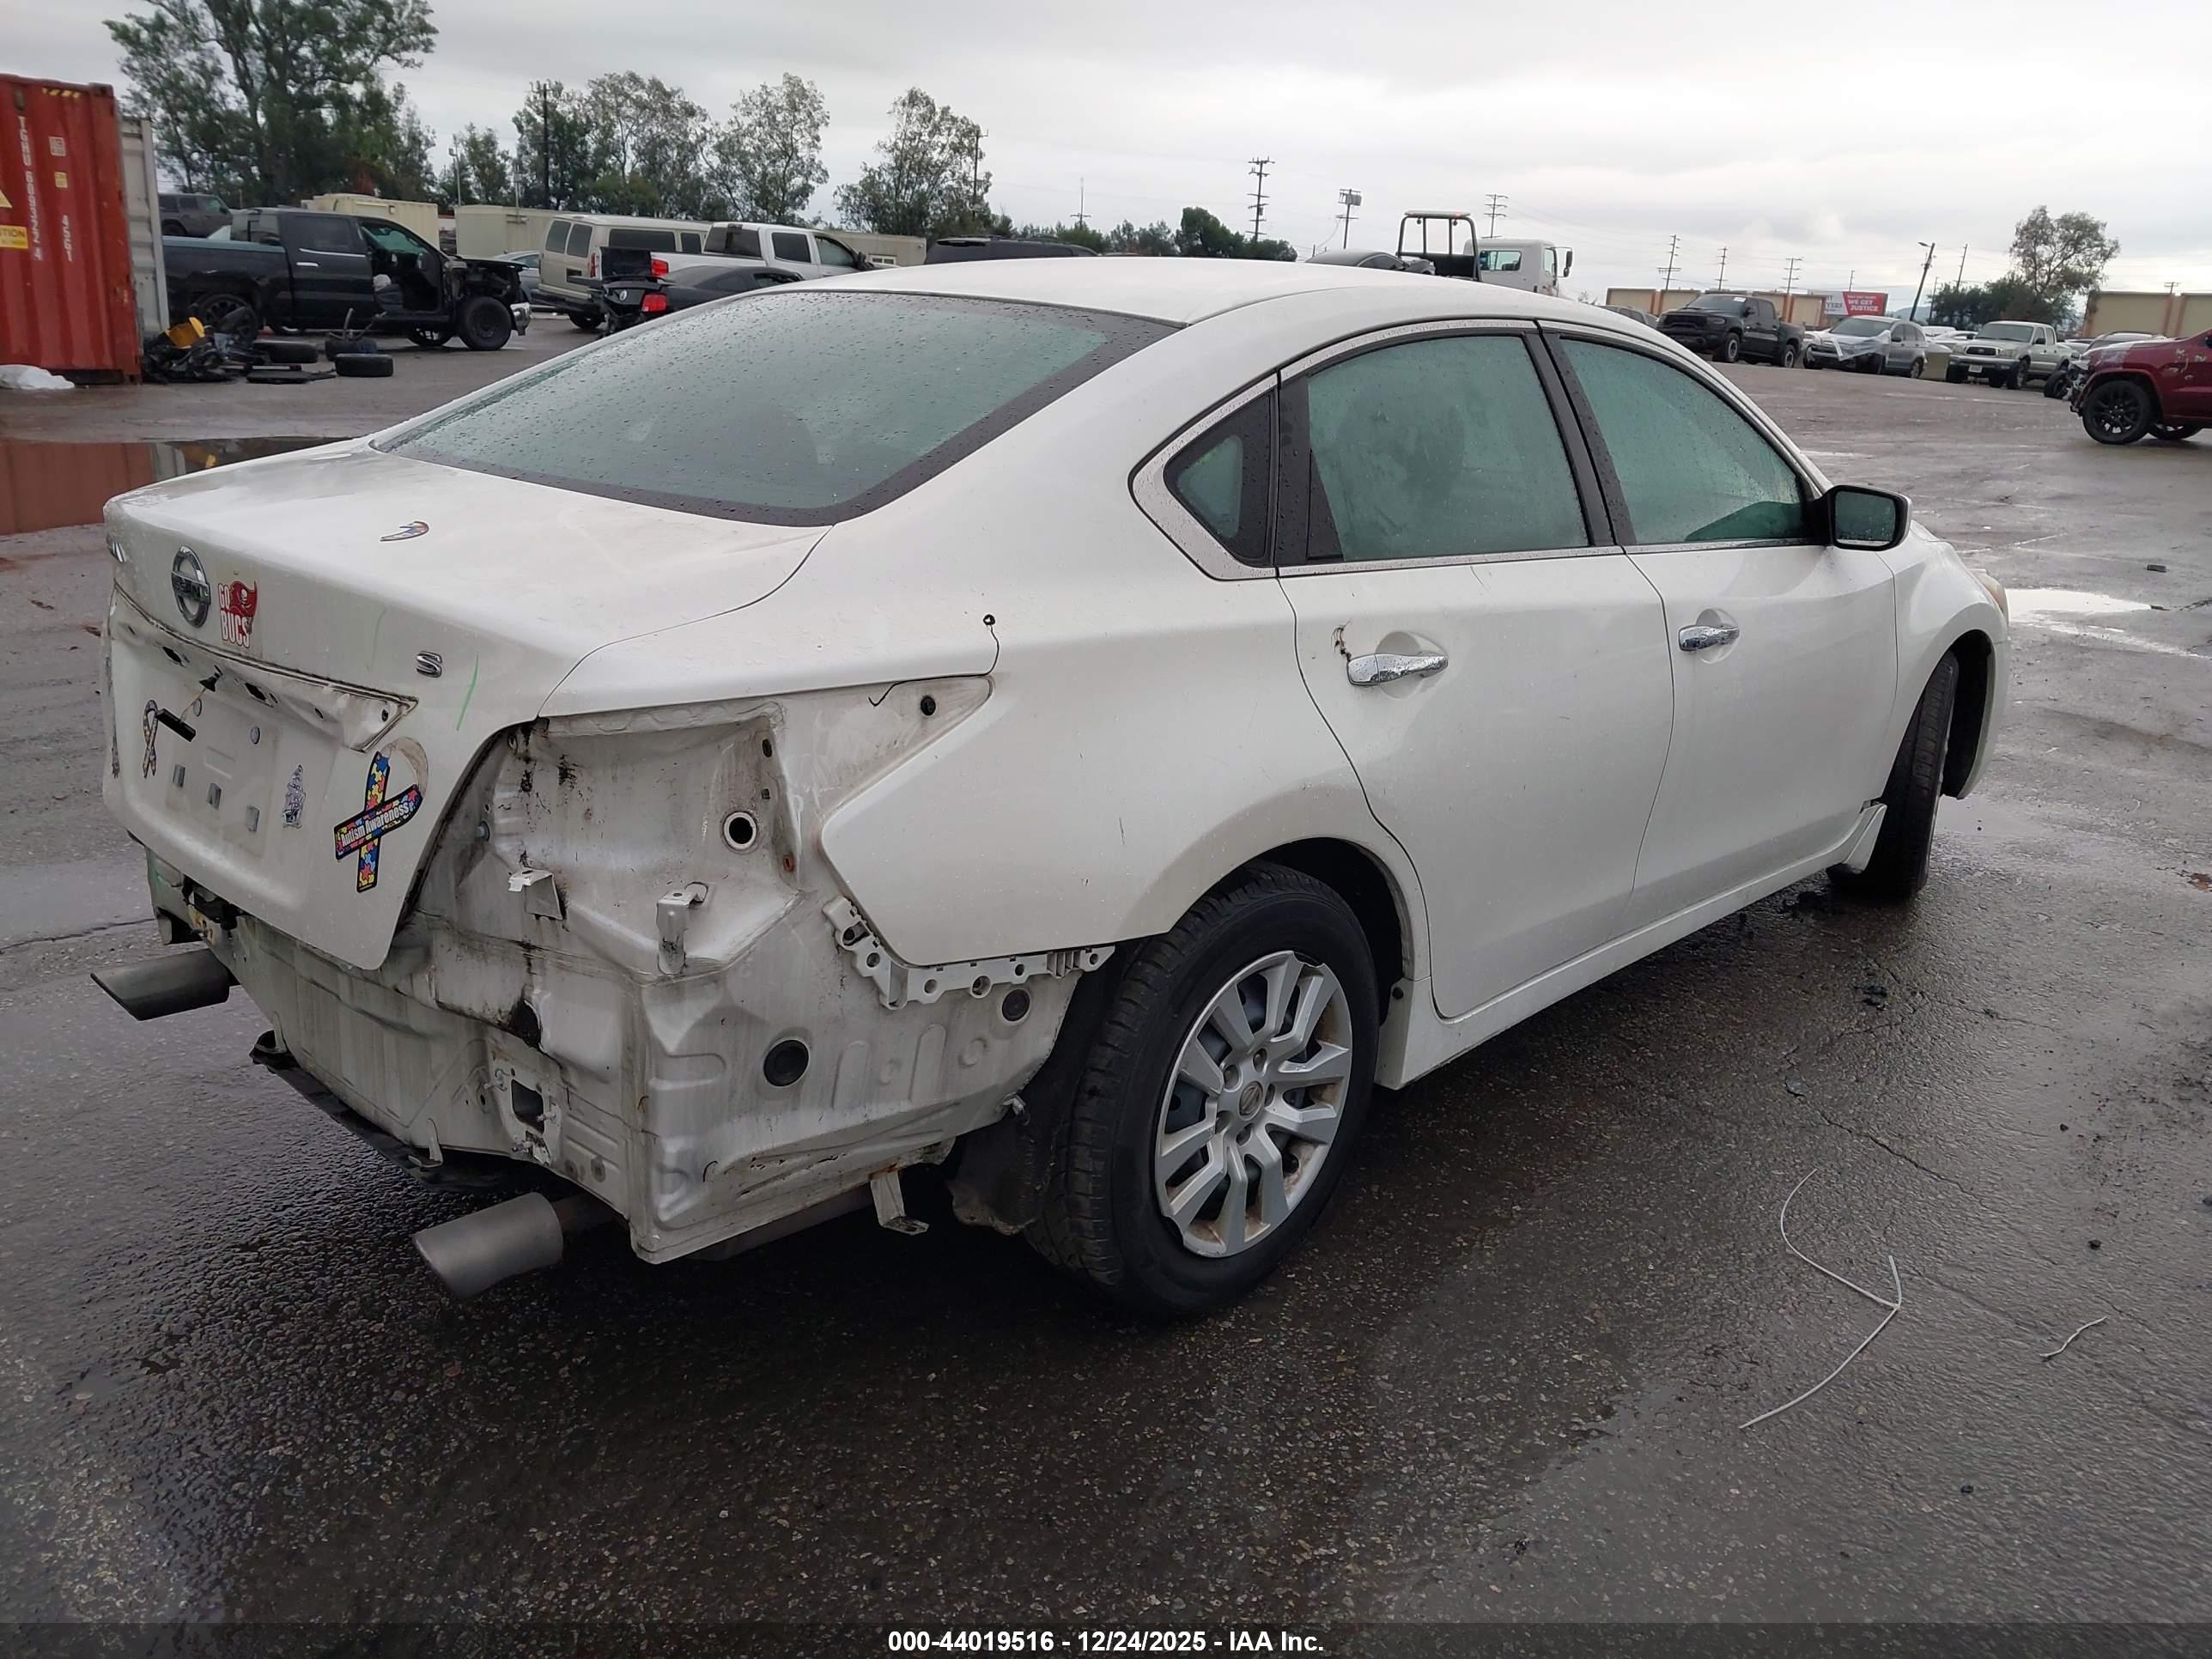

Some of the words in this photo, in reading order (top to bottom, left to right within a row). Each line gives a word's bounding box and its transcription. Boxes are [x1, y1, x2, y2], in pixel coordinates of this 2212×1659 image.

[218, 583, 231, 611] GO
[221, 610, 251, 649] BUCS
[416, 651, 442, 678] S
[340, 823, 366, 848] Autism
[364, 801, 410, 835] Awareness
